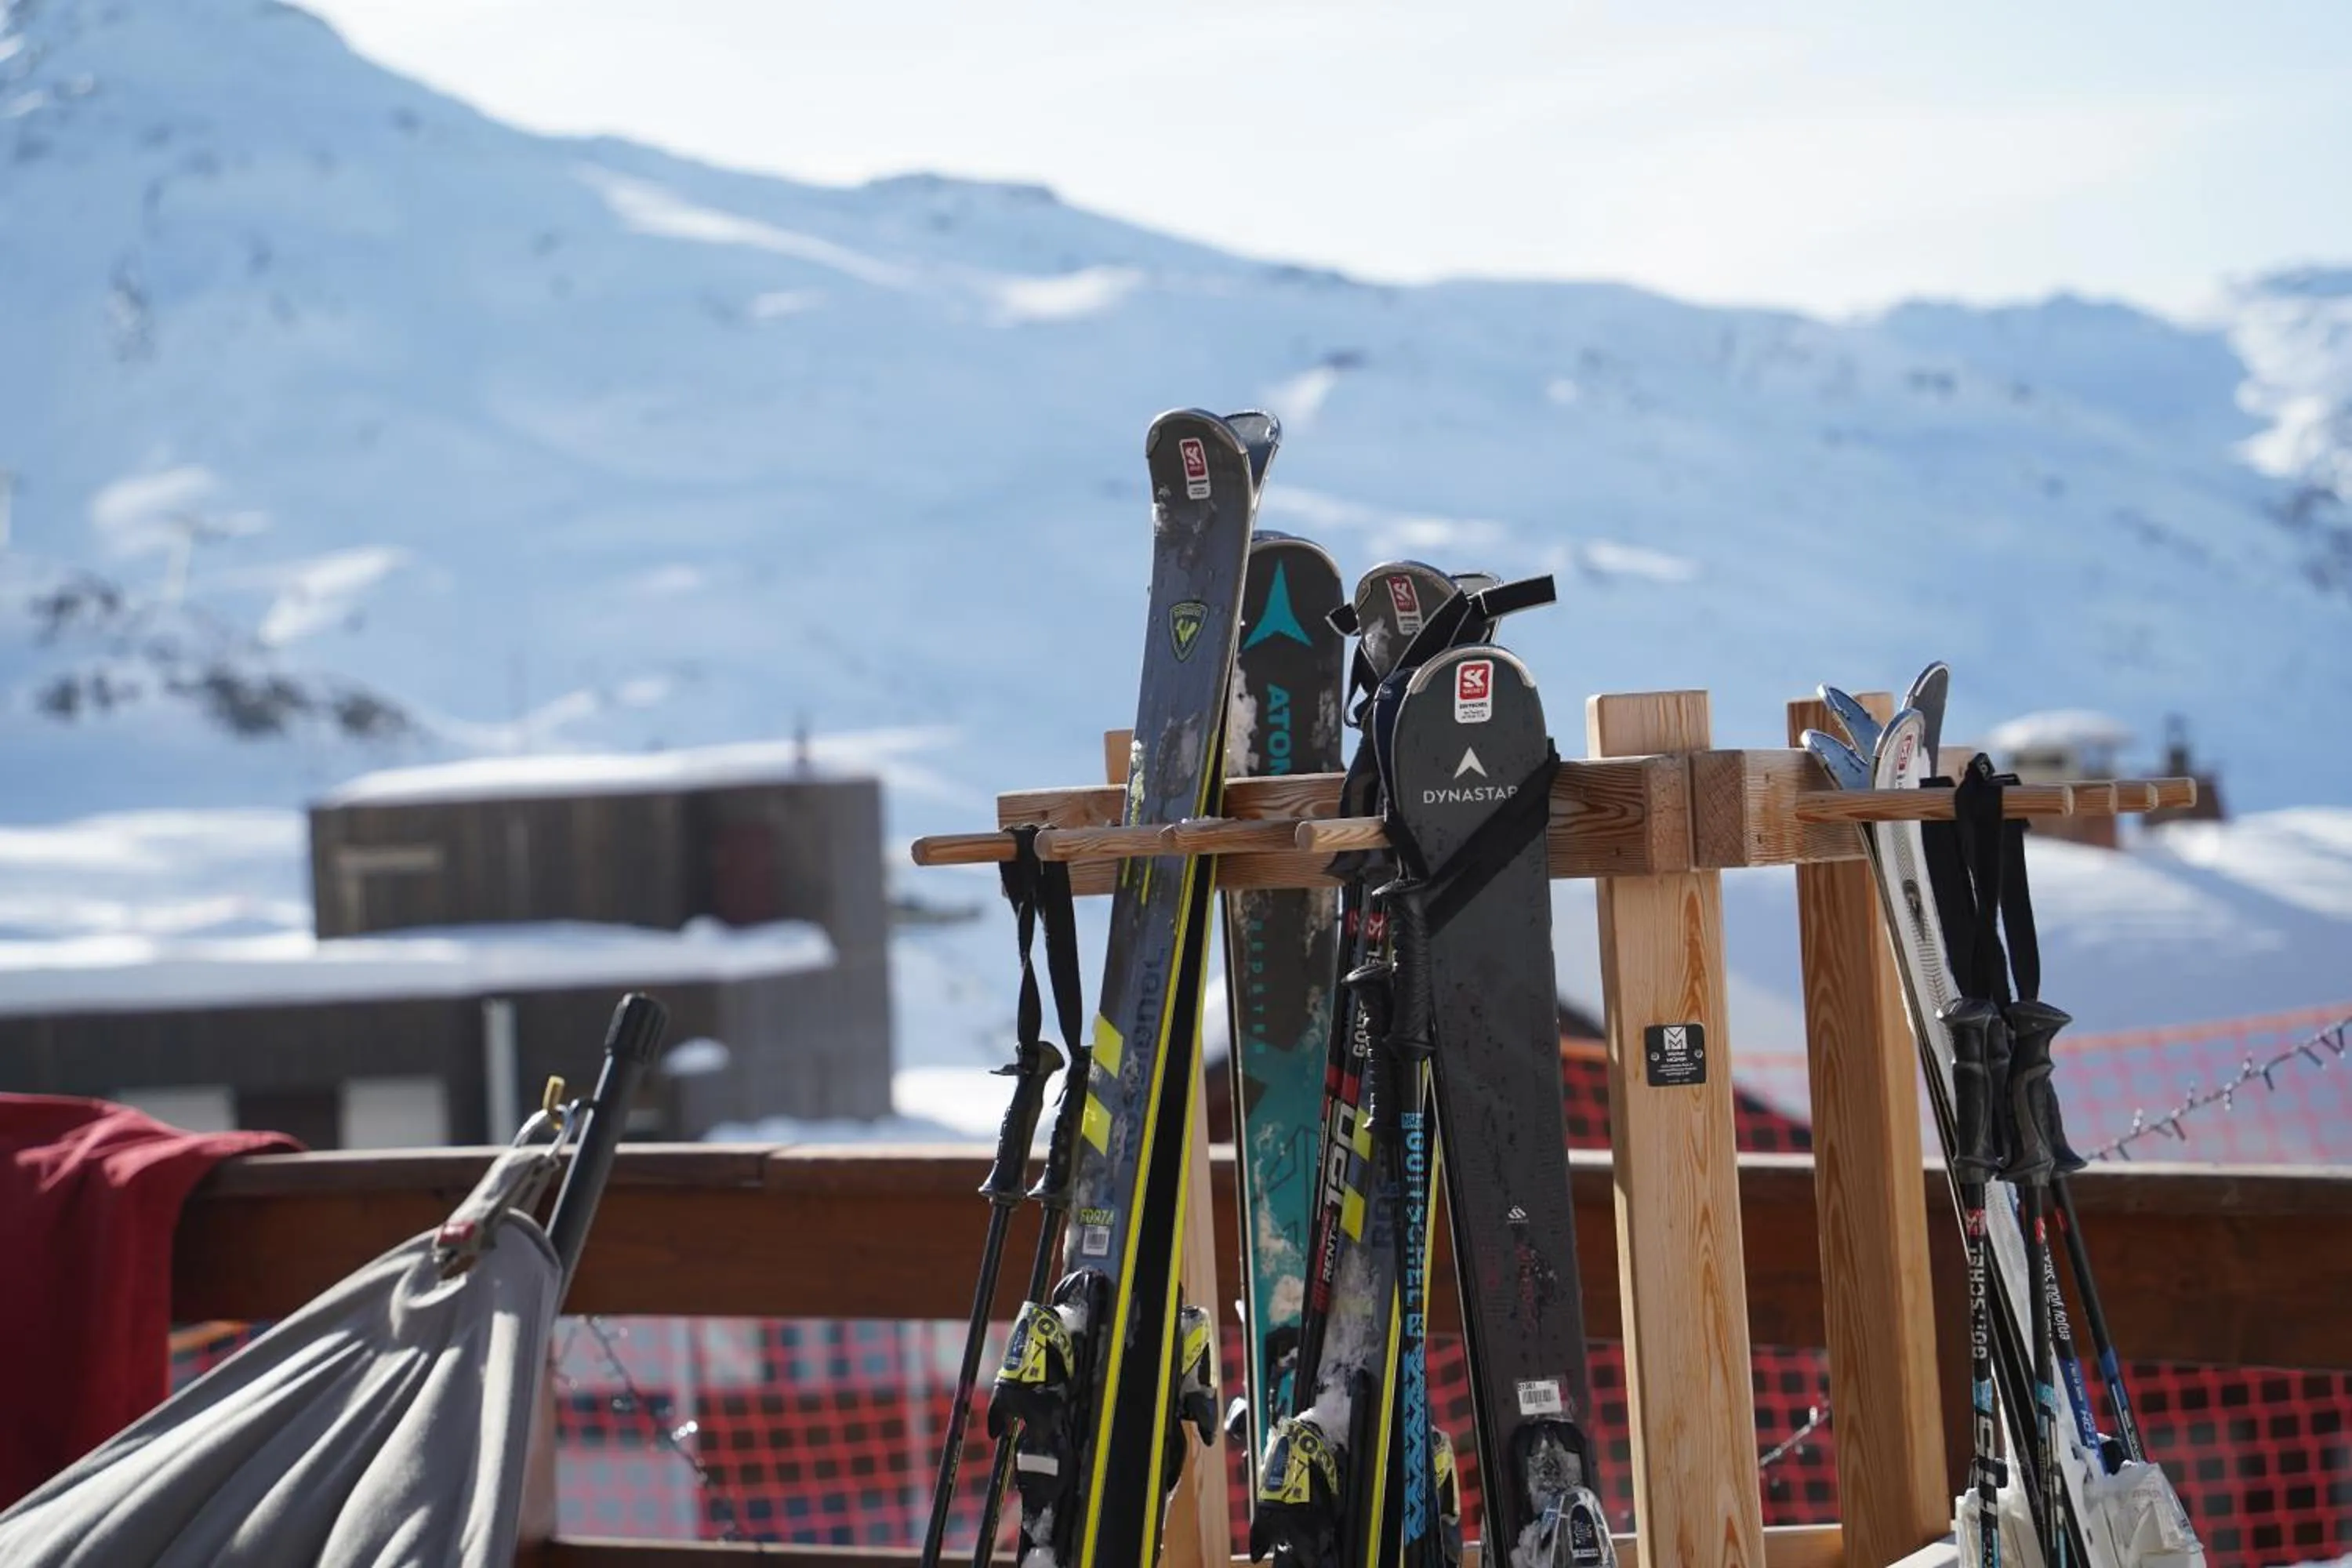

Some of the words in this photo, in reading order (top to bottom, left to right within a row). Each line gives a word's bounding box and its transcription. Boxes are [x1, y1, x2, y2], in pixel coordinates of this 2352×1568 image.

[1266, 682, 1292, 776] ATOM
[1321, 1229, 1338, 1283] RENT
[2053, 1309, 2071, 1341] enjoy
